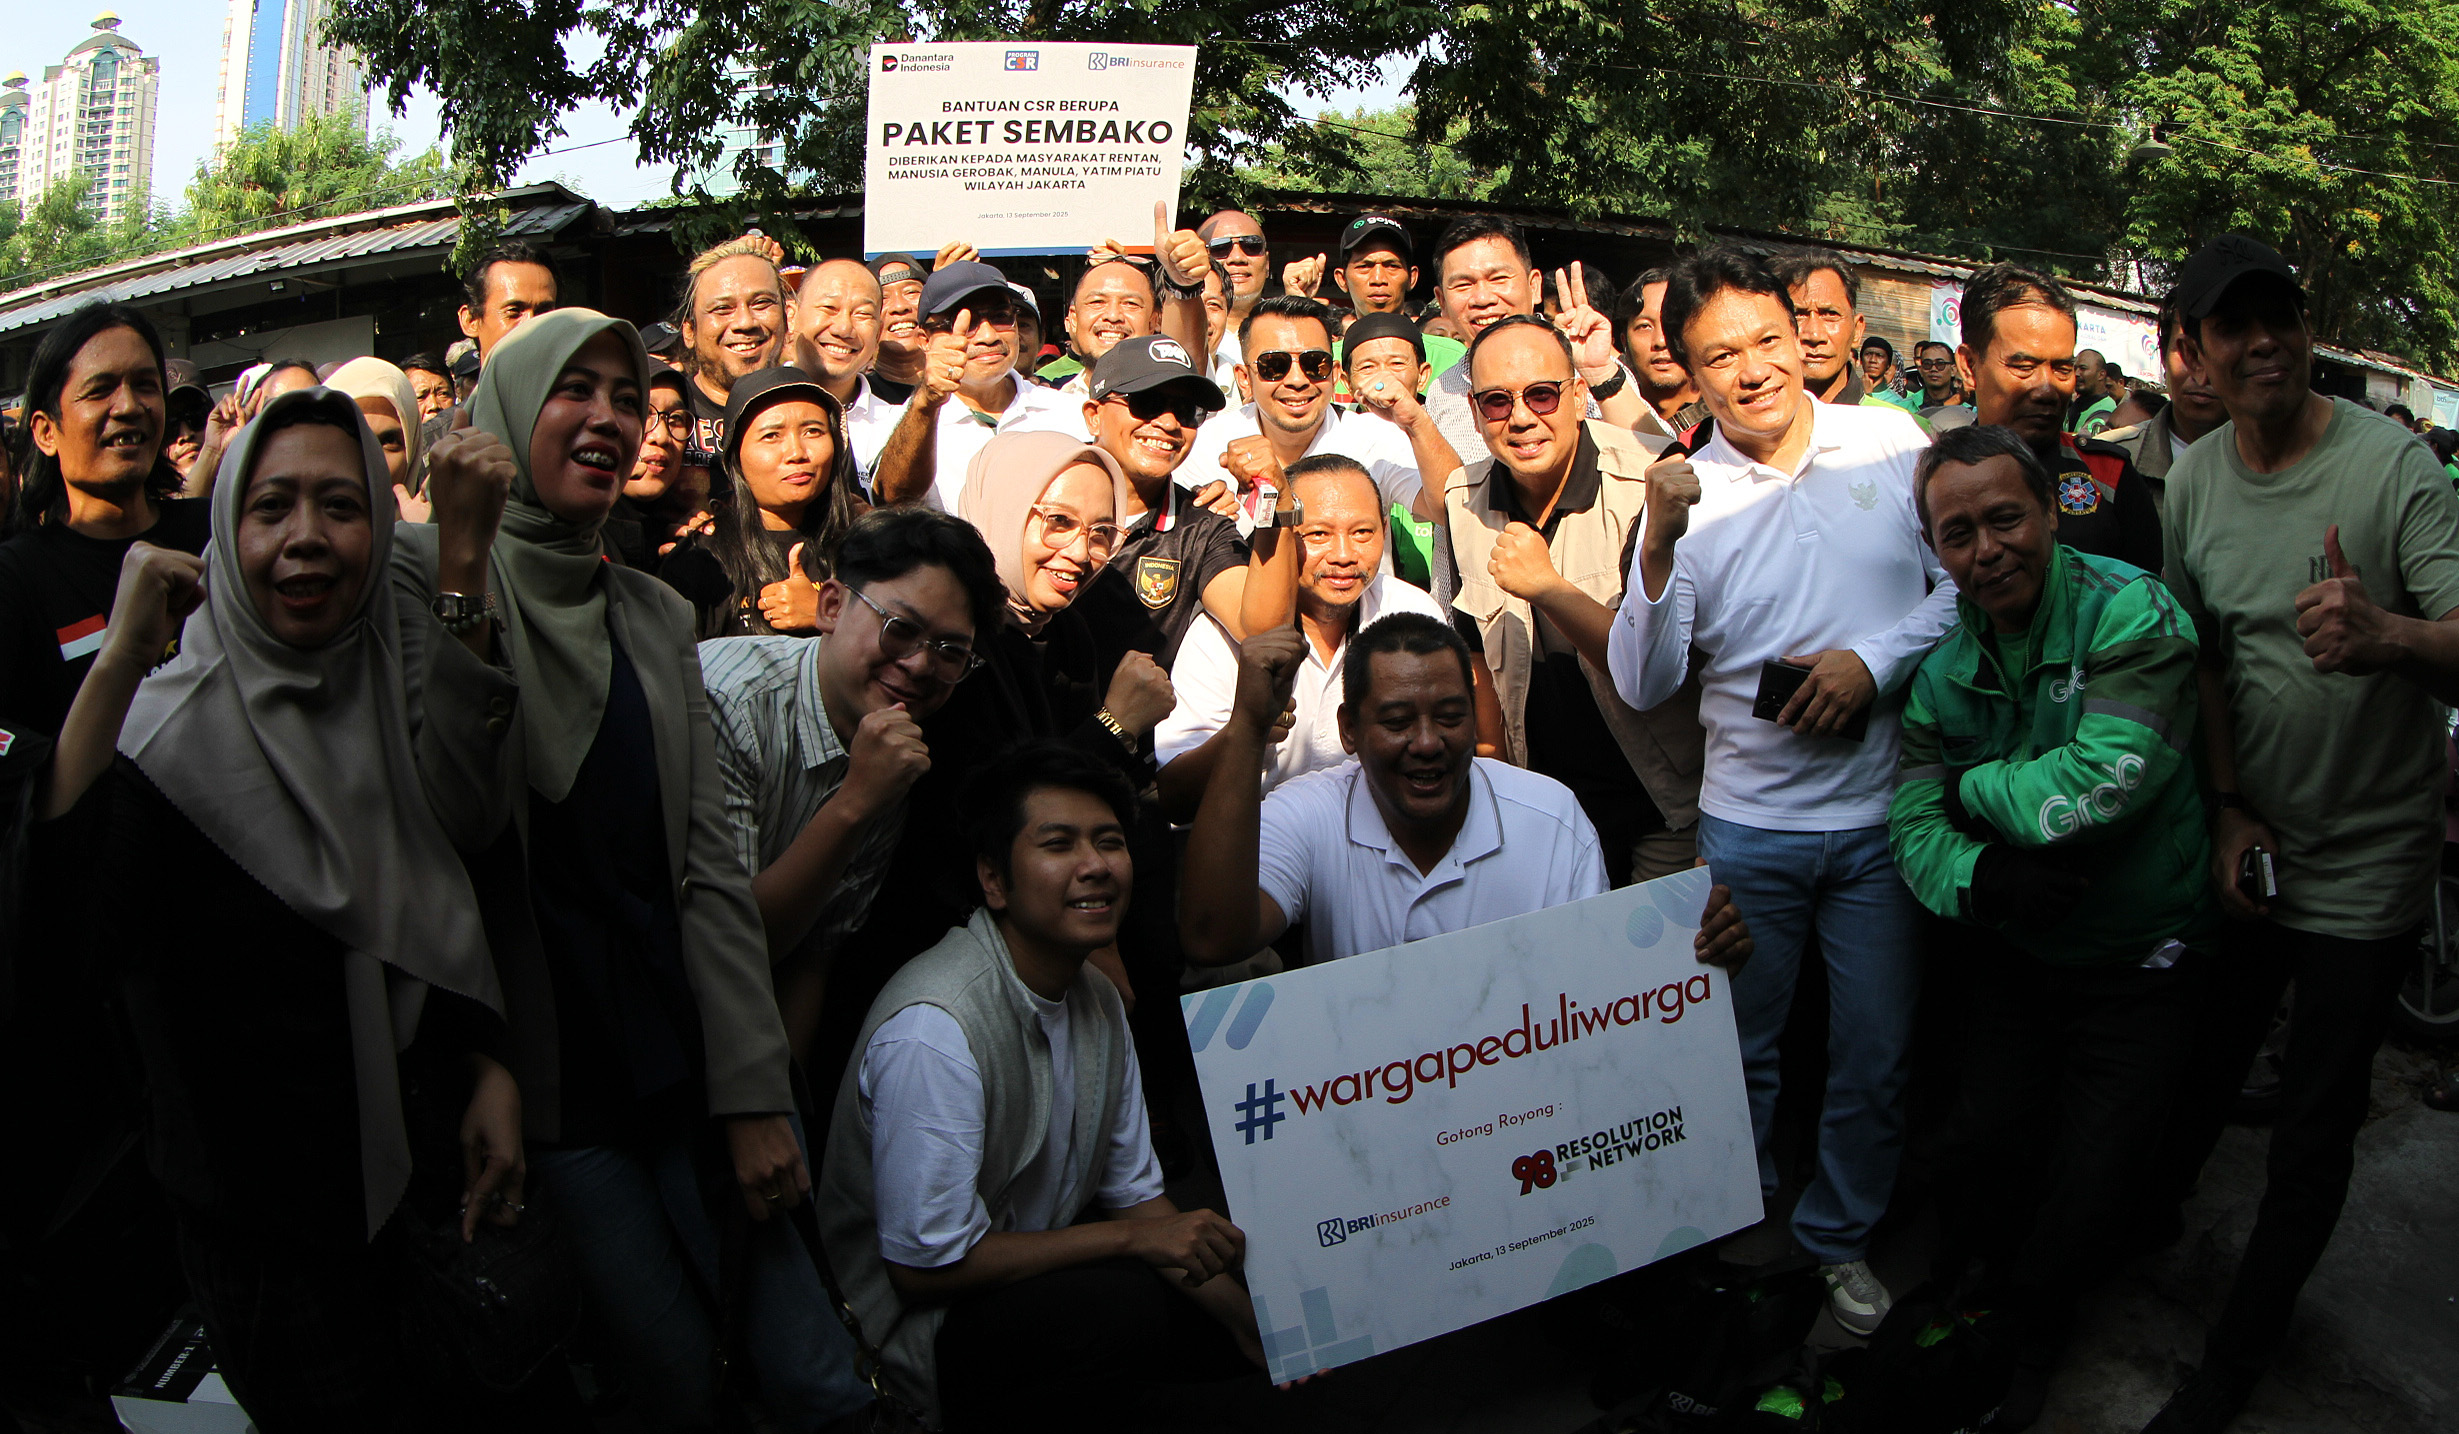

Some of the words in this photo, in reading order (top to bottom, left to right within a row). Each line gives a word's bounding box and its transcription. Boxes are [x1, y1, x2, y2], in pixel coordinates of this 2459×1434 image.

[901, 54, 954, 63] Danantara
[1006, 57, 1036, 70] CSR
[1110, 57, 1185, 69] BRIinsurance
[900, 63, 950, 72] Indonesia
[942, 101, 1019, 113] BANTUAN
[1024, 100, 1055, 112] CSR
[1060, 101, 1119, 112] BERUPA
[883, 120, 994, 147] PAKET
[1003, 120, 1172, 144] SEMBAKO
[889, 155, 957, 166] DIBERIKAN
[962, 154, 1012, 164] KEPADA
[1016, 153, 1105, 163] MASYARAKAT
[1109, 154, 1162, 164] RENTAN,
[888, 169, 949, 180] MANUSIA
[953, 168, 1016, 178] GEROBAK,
[1021, 167, 1079, 178] MANULA,
[1083, 167, 1121, 176] YATIM
[1125, 167, 1160, 176] PIATU
[965, 181, 1023, 191] WILAYAH
[1027, 180, 1085, 190] JAKARTA
[1367, 217, 1402, 230] gojek
[1145, 562, 1174, 571] INDONESIA
[2039, 753, 2146, 841] Grab
[1234, 973, 1711, 1146] #wargapeduliwarga
[1436, 1122, 1493, 1145] Gotong
[1498, 1104, 1554, 1128] Royong
[1511, 1149, 1557, 1196] 98
[1556, 1105, 1683, 1162] RESOLUTION
[1588, 1123, 1687, 1172] NETWORK
[1346, 1196, 1450, 1234] BRIinsurance
[1449, 1251, 1494, 1271] Jakarta,
[1495, 1245, 1506, 1256] 13
[1508, 1226, 1567, 1251] September
[1569, 1215, 1595, 1232] 2025
